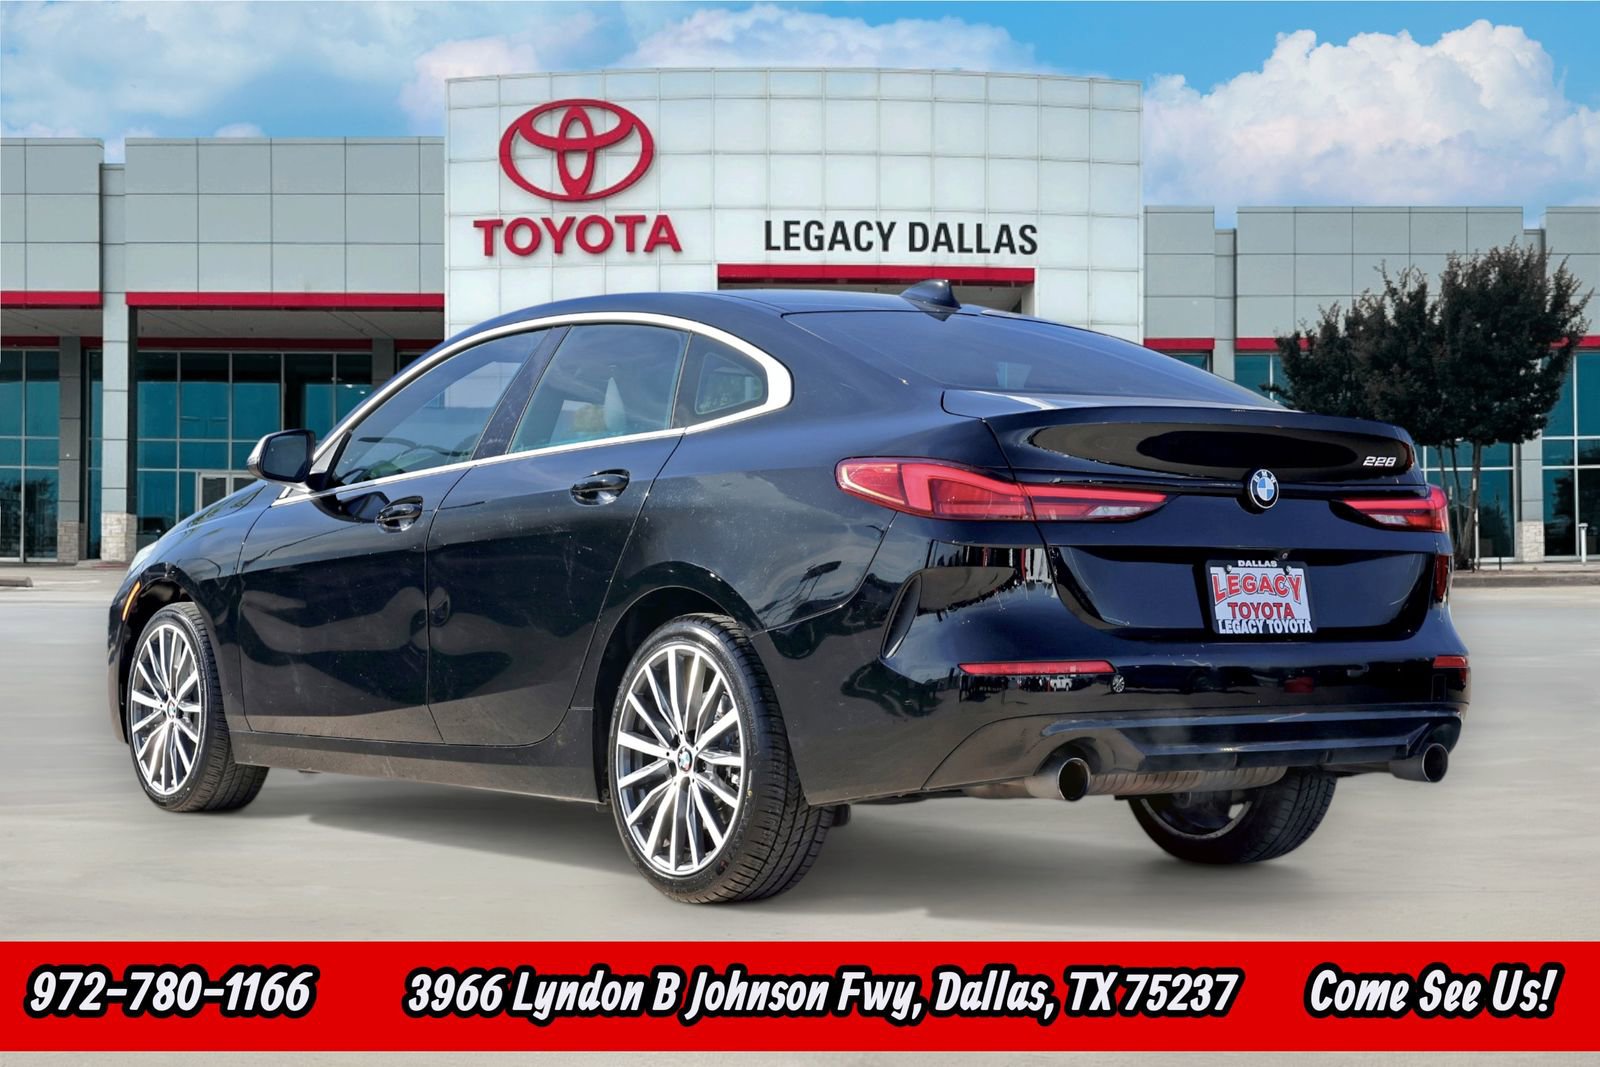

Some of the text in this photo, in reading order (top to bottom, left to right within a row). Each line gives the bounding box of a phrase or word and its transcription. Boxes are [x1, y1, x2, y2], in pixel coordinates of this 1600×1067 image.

[474, 214, 681, 256] TOYOTA
[764, 220, 1038, 255] LEGACY DALLAS
[1362, 455, 1398, 468] 228
[1253, 469, 1277, 484] BMW
[1236, 559, 1278, 568] DALLAS
[1211, 573, 1302, 605] LEGACY
[1227, 601, 1296, 620] TOYOTA
[1217, 618, 1314, 634] LEGACY TOYOTA
